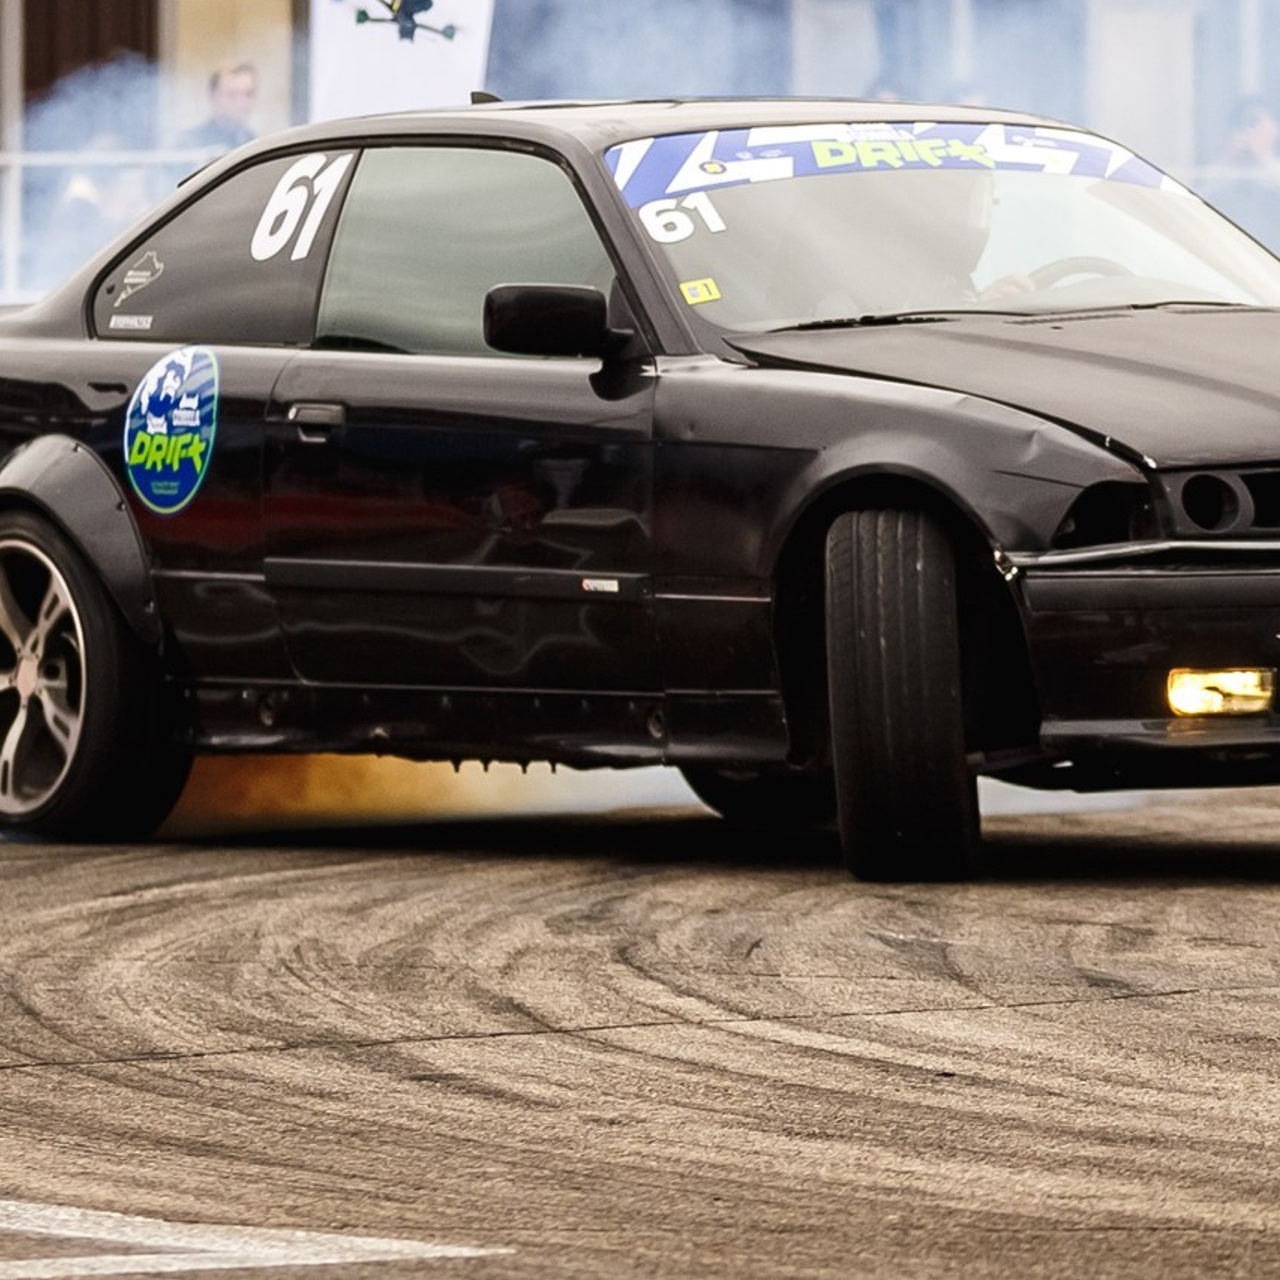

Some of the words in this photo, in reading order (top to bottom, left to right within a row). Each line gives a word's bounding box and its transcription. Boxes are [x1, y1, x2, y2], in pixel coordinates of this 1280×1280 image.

[810, 138, 995, 169] DRIFT
[251, 153, 354, 261] 61
[638, 191, 727, 244] 61
[128, 430, 207, 474] DRIFT
